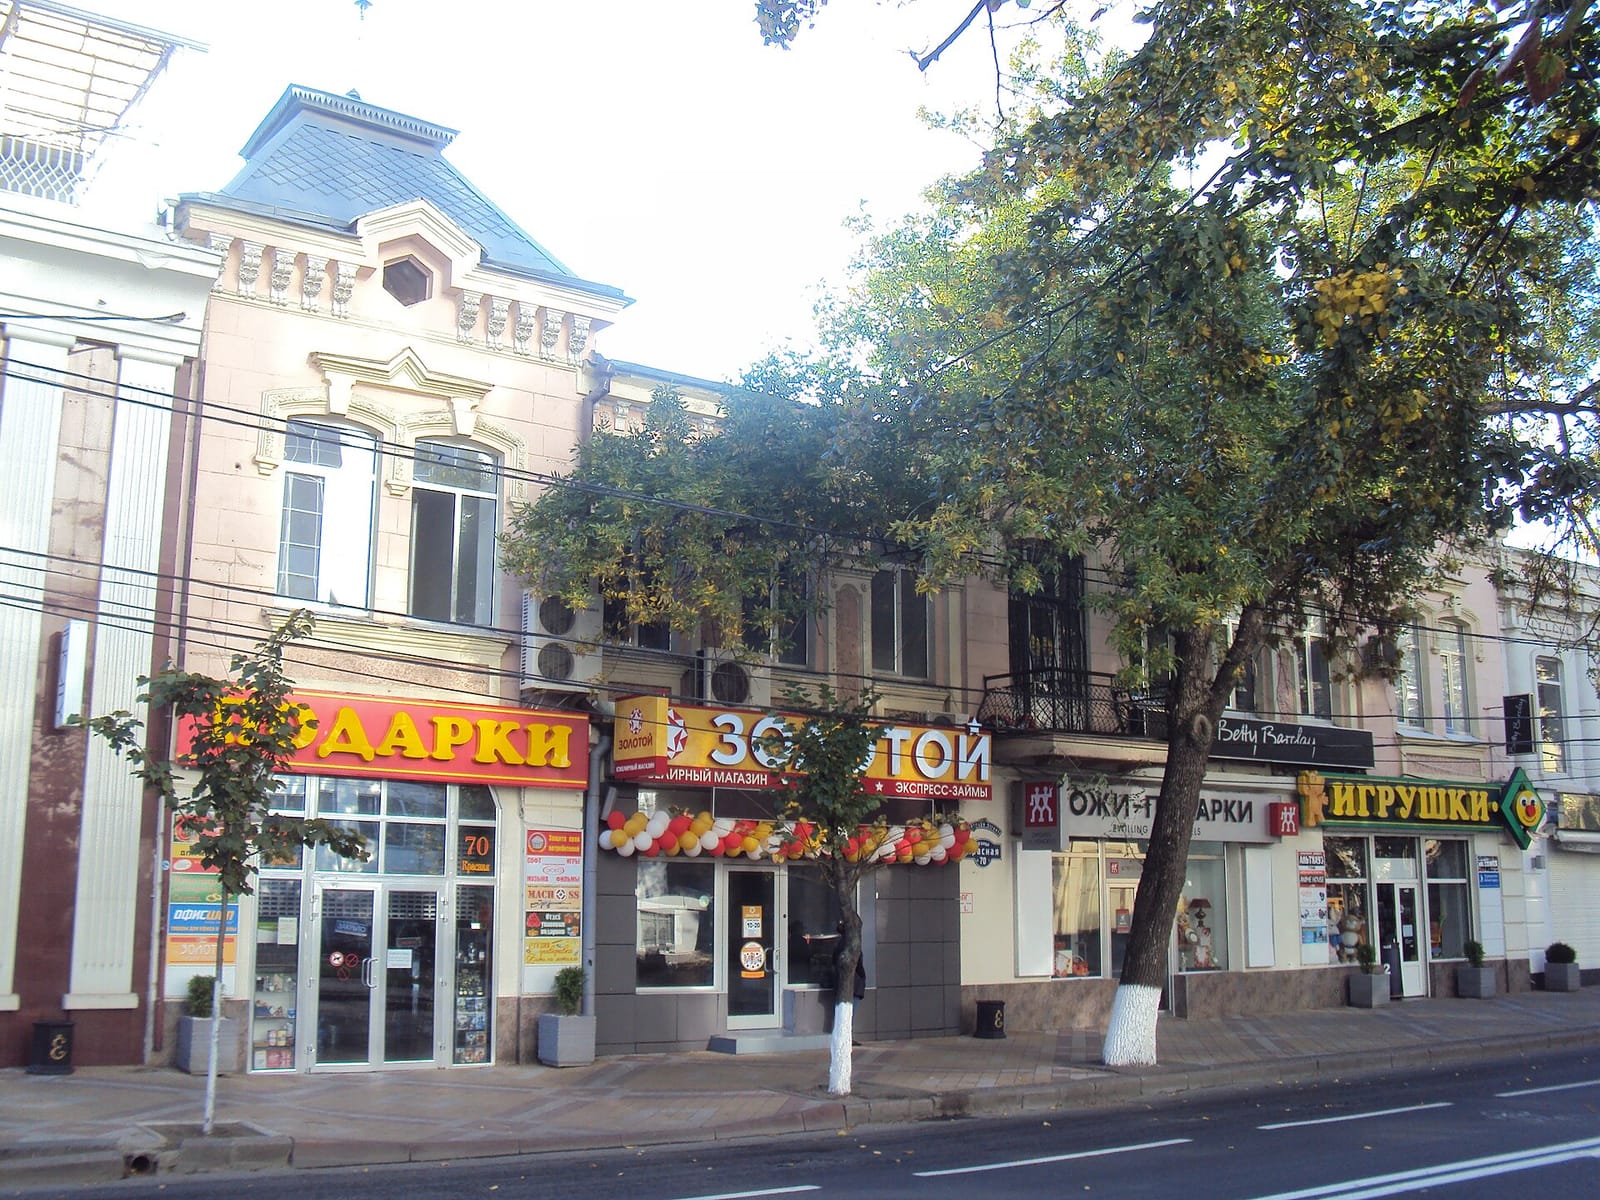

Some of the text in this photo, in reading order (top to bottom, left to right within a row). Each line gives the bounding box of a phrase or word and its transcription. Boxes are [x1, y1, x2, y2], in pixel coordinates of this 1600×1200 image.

[618, 732, 653, 750] ЗОЛОТОЙ
[711, 713, 990, 781] ЗОТОЙ
[1218, 720, 1316, 758] Betty Barclay
[714, 771, 768, 786] МАГАЗИН
[895, 781, 988, 798] ЭКСПРЕСС-ЗАЙМЫ
[1331, 782, 1490, 822] ИГРУШКИ
[465, 836, 489, 856] 70
[979, 857, 987, 866] 70
